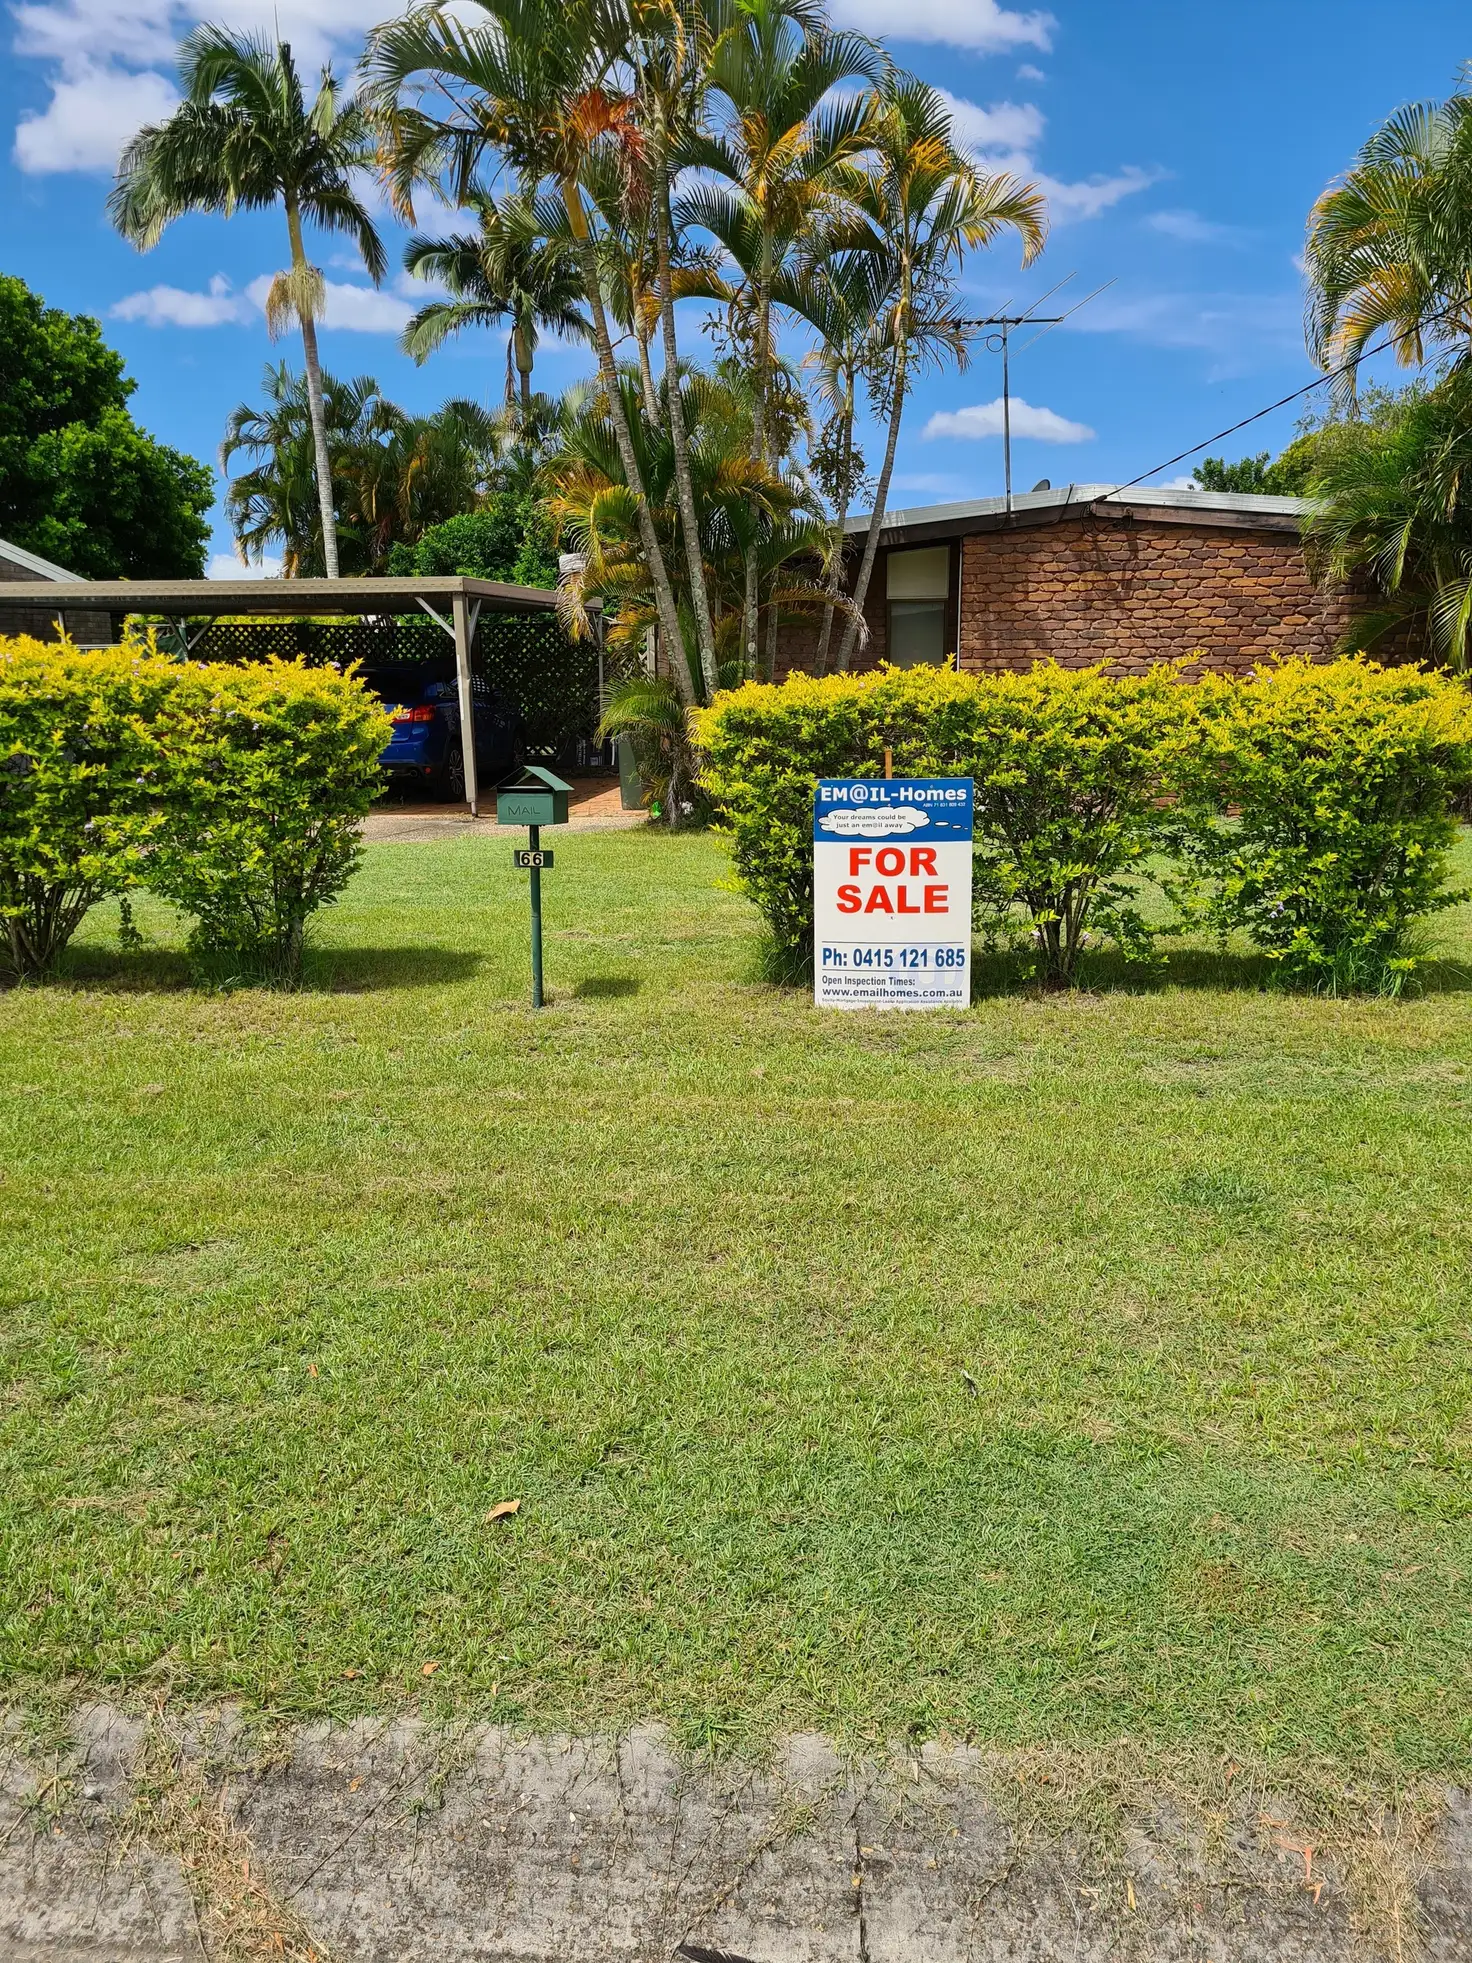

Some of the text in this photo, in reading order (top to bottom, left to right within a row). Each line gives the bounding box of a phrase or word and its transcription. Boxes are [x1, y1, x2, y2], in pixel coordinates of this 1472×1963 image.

[821, 784, 967, 803] EM@IL-Homes
[508, 806, 540, 816] MAIL
[521, 853, 542, 866] 66
[849, 847, 939, 877] FOR
[836, 884, 949, 914] SALE
[822, 948, 965, 967] Ph: 0415 121 685
[822, 975, 916, 987] Open Inspection Times:
[822, 988, 963, 997] www.emailhomes.com.au
